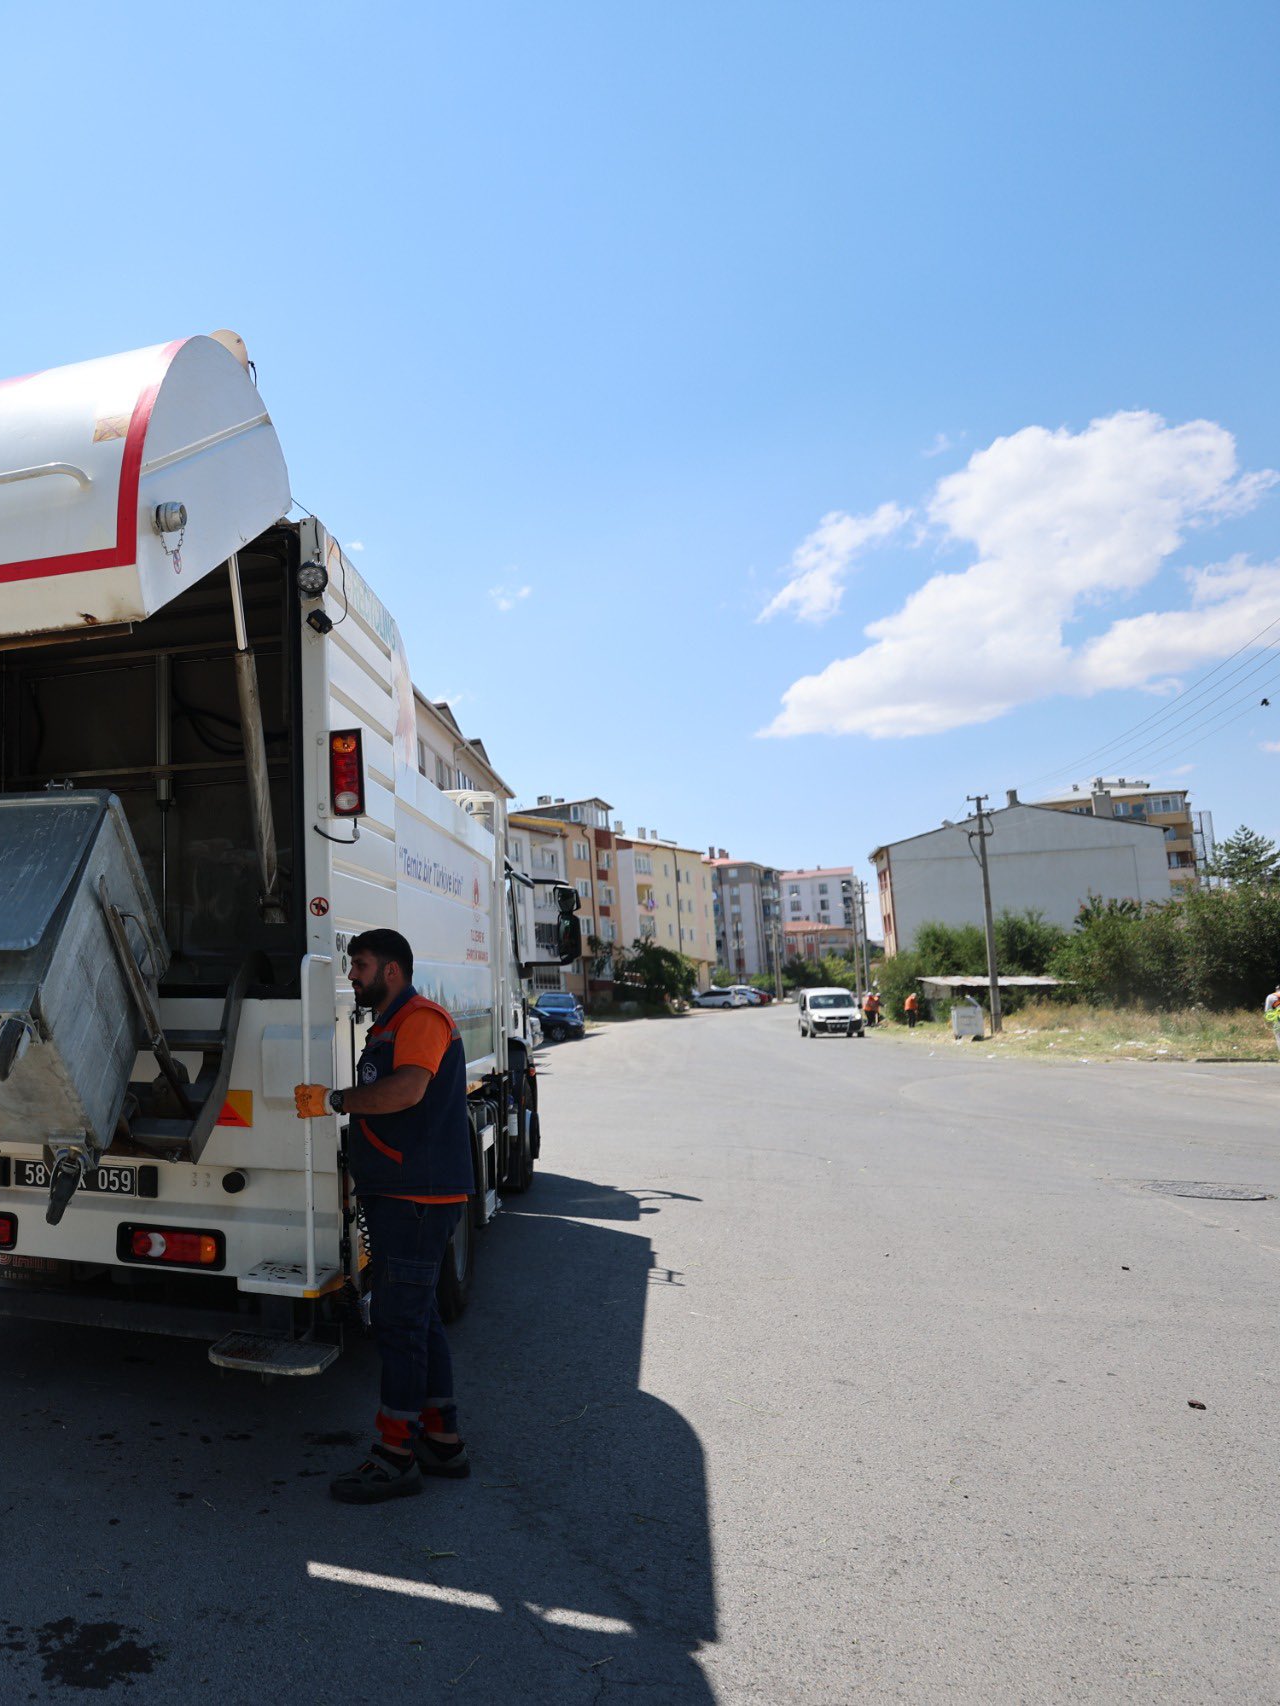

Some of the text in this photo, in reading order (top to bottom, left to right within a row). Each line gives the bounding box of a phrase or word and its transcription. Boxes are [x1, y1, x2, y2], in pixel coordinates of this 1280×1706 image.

[423, 857, 432, 883] bir
[433, 861, 452, 895] Türkiye
[25, 1163, 46, 1186] 58
[97, 1168, 132, 1192] 059
